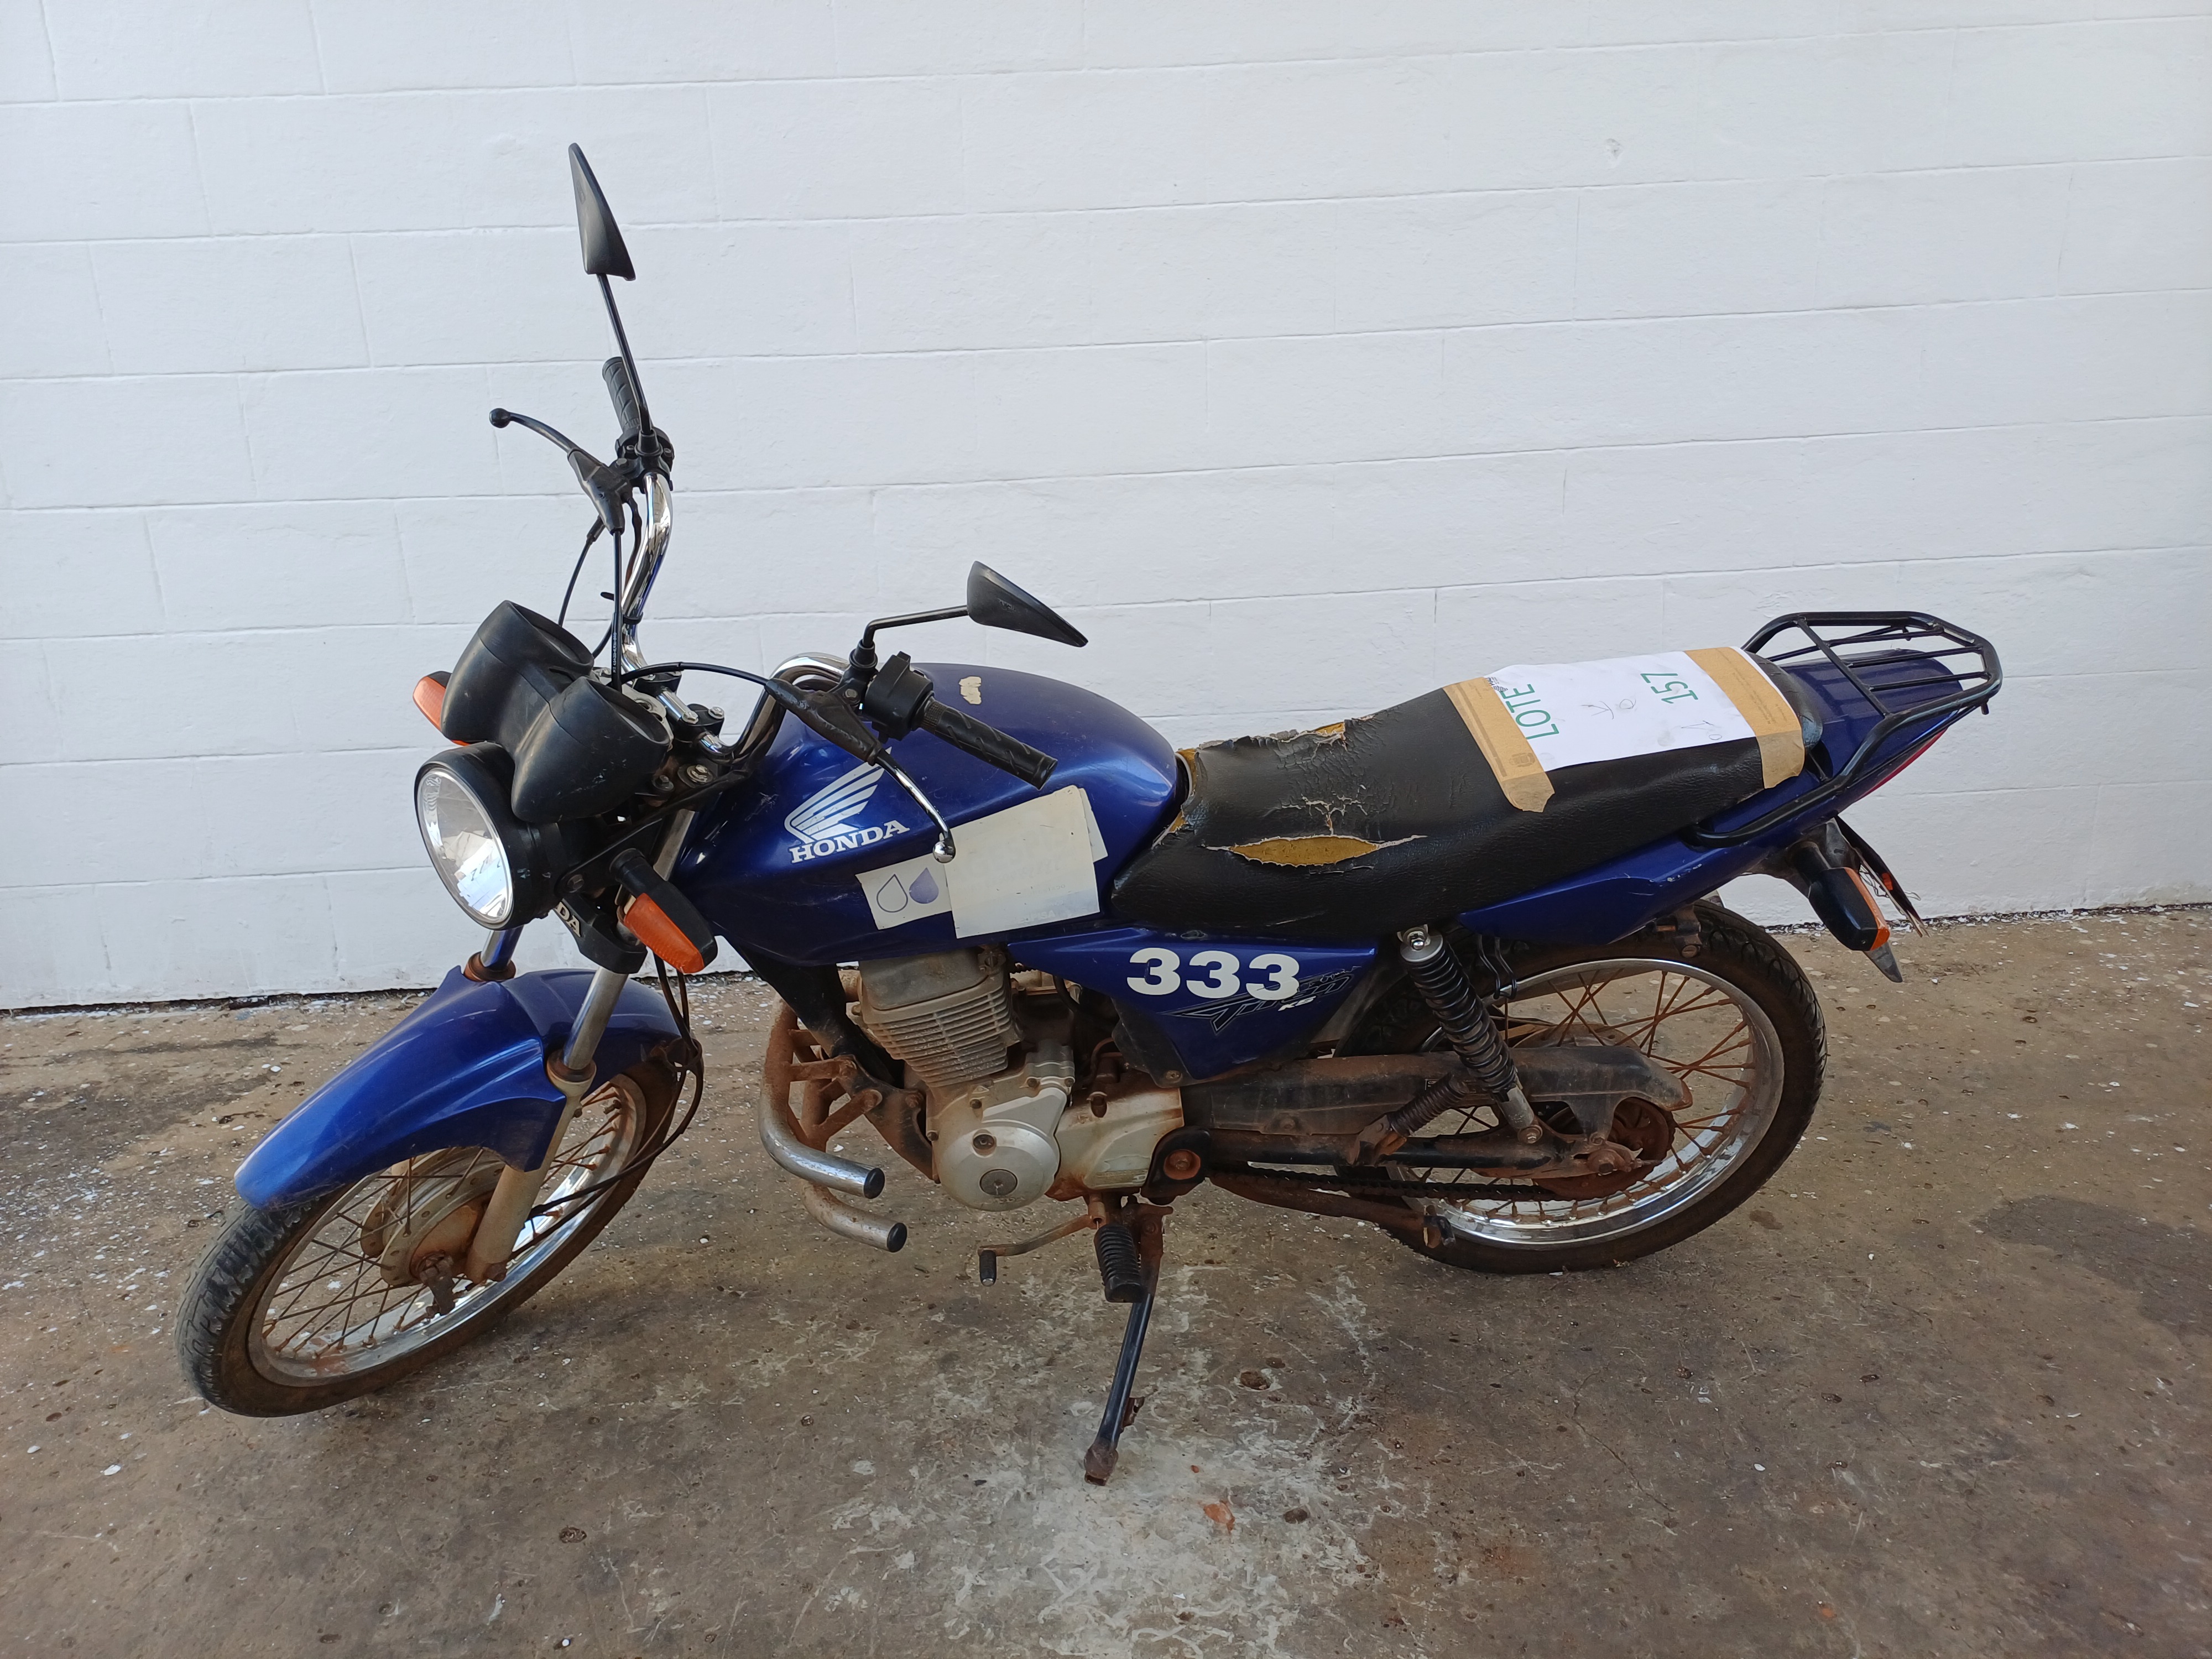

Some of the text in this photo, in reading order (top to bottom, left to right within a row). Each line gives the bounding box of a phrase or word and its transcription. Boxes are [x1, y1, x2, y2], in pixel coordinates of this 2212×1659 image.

[1499, 684, 1560, 740] LOTE
[1640, 672, 1699, 705] 157
[790, 820, 910, 864] HONDA
[1126, 947, 1300, 1000] 333
